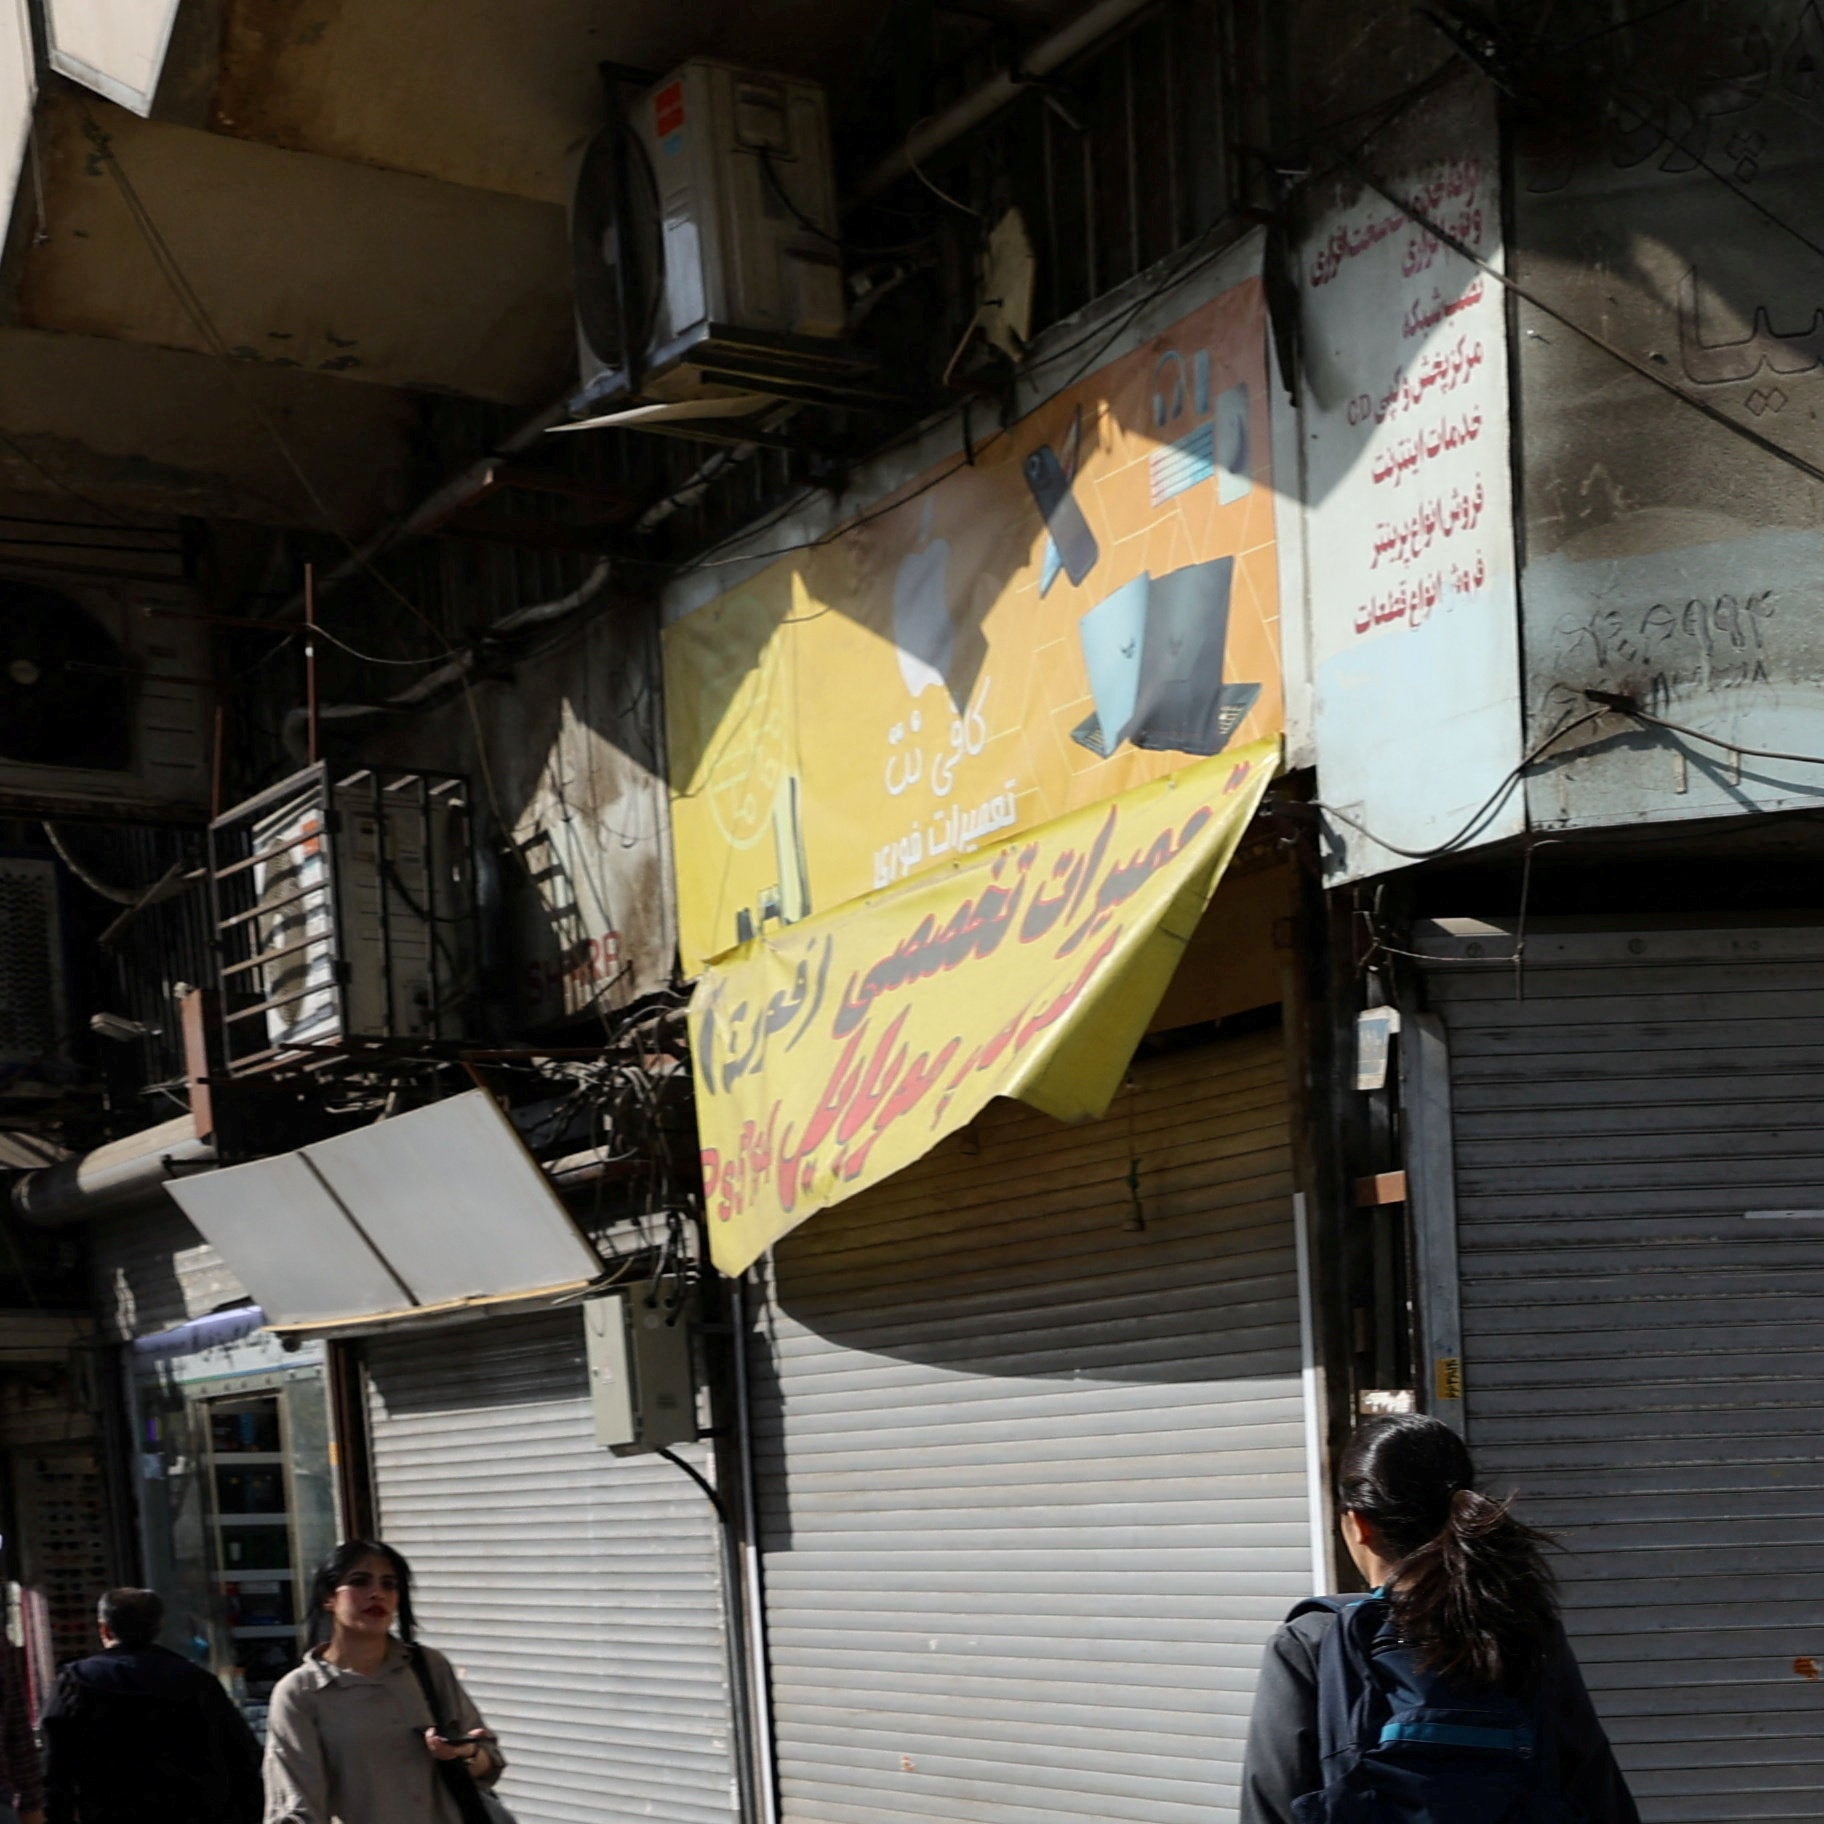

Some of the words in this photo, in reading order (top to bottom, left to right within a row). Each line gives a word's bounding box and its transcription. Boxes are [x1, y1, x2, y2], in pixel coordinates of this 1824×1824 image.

[1448, 333, 1485, 391] مرکز
[1347, 393, 1372, 426] CD
[1426, 404, 1483, 459] خدمات
[1371, 429, 1425, 490] اینترنت
[1410, 496, 1443, 559] انواع
[1442, 471, 1484, 538] فروش
[1369, 520, 1411, 570] پرینتر
[1354, 580, 1407, 635] قطعات
[1409, 570, 1443, 632] انواع
[885, 708, 923, 796] نت
[931, 676, 991, 798] کافی
[928, 777, 1018, 857] تعمیرات
[872, 819, 923, 890] فوری
[831, 839, 1039, 1040] تخصصی
[779, 1003, 963, 1212] موبایل
